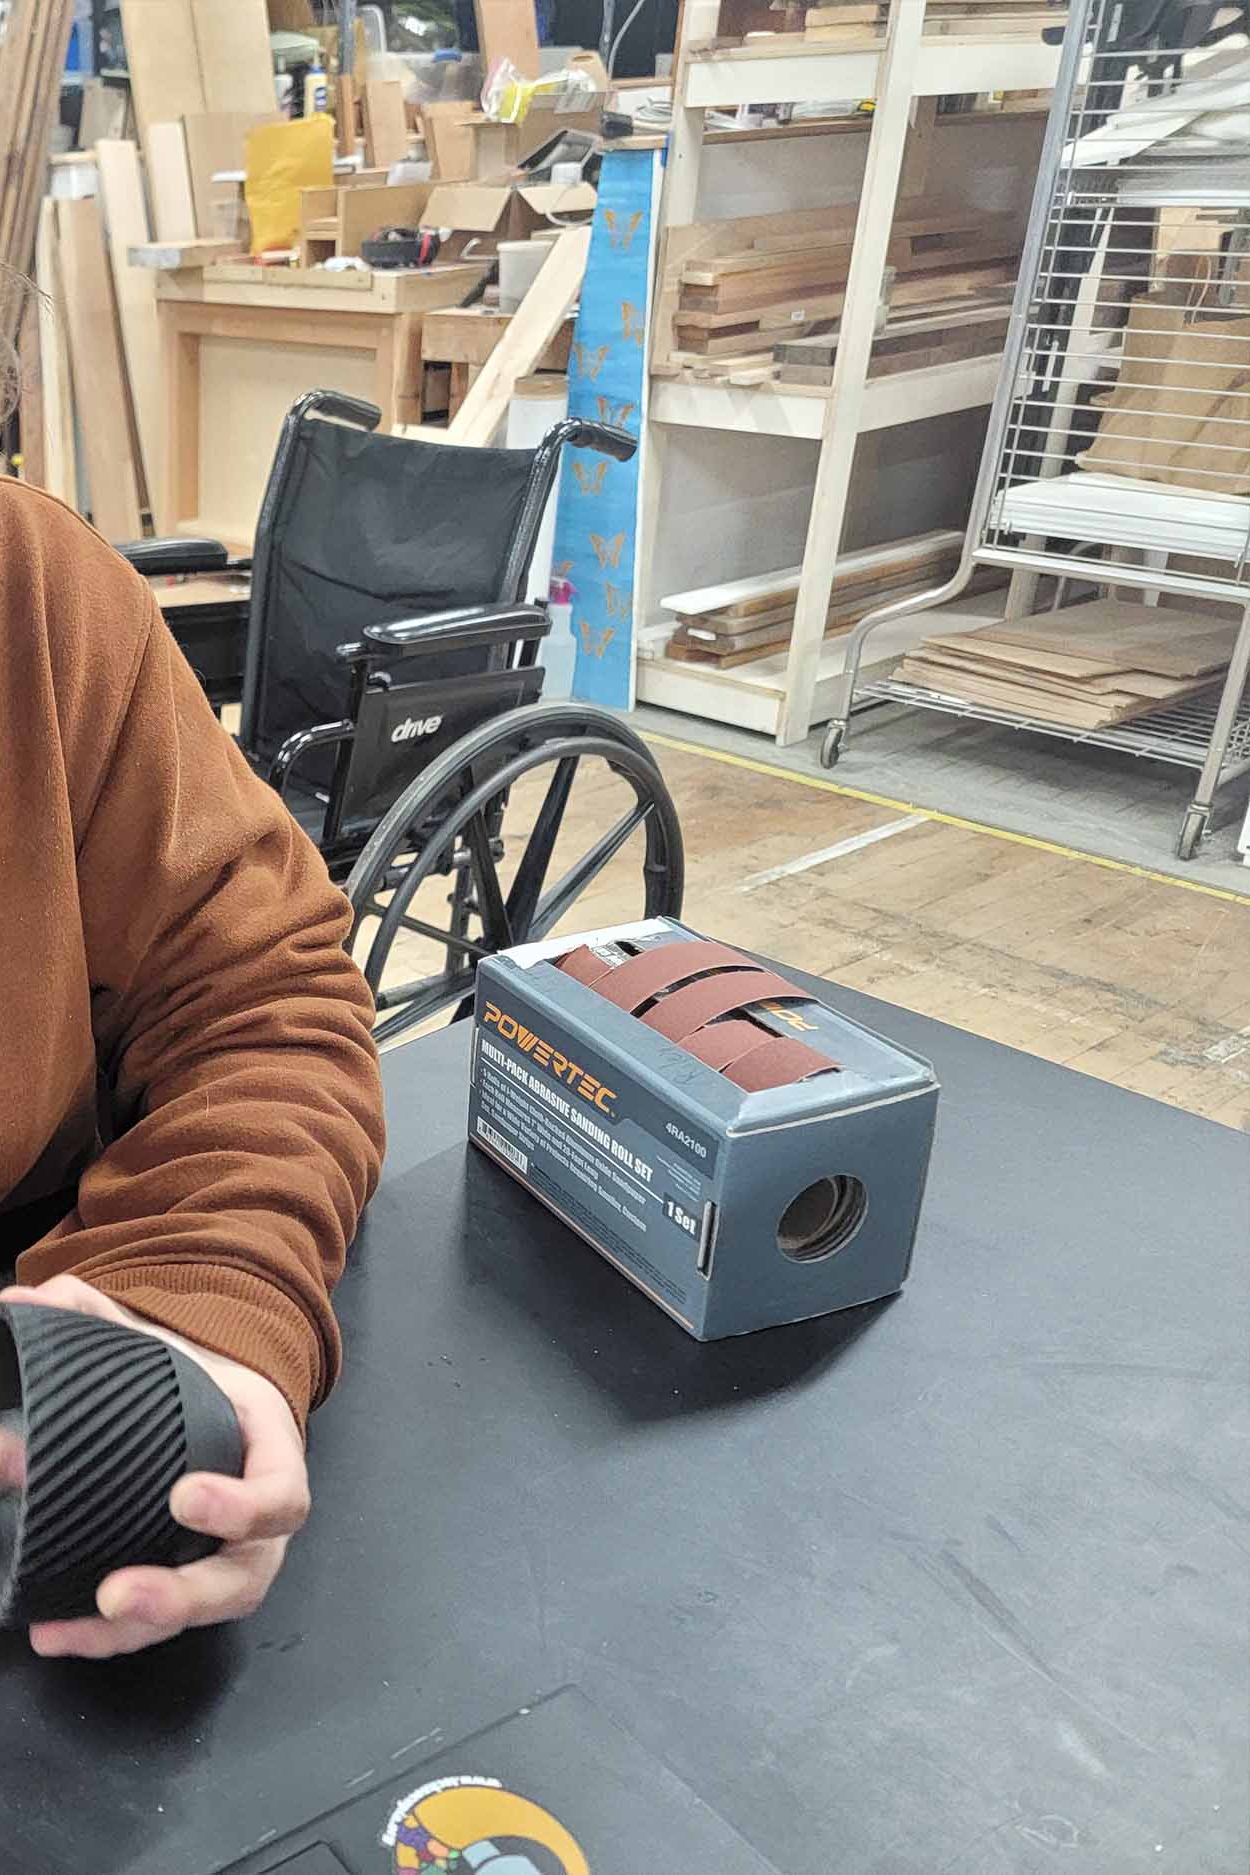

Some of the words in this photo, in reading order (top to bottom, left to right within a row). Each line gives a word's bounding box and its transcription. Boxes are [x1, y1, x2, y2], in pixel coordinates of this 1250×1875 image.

[391, 715, 442, 742] drive
[483, 1001, 618, 1114] POWERTEC
[481, 1039, 528, 1085] MULTI-PACK
[529, 1076, 570, 1118] ABRASIVE
[570, 1107, 610, 1149] SANDING
[611, 1140, 634, 1169] ROLL
[634, 1158, 654, 1182] SET
[665, 1122, 707, 1158] 4RA2100
[667, 1201, 674, 1217] 1
[674, 1206, 696, 1236] Set
